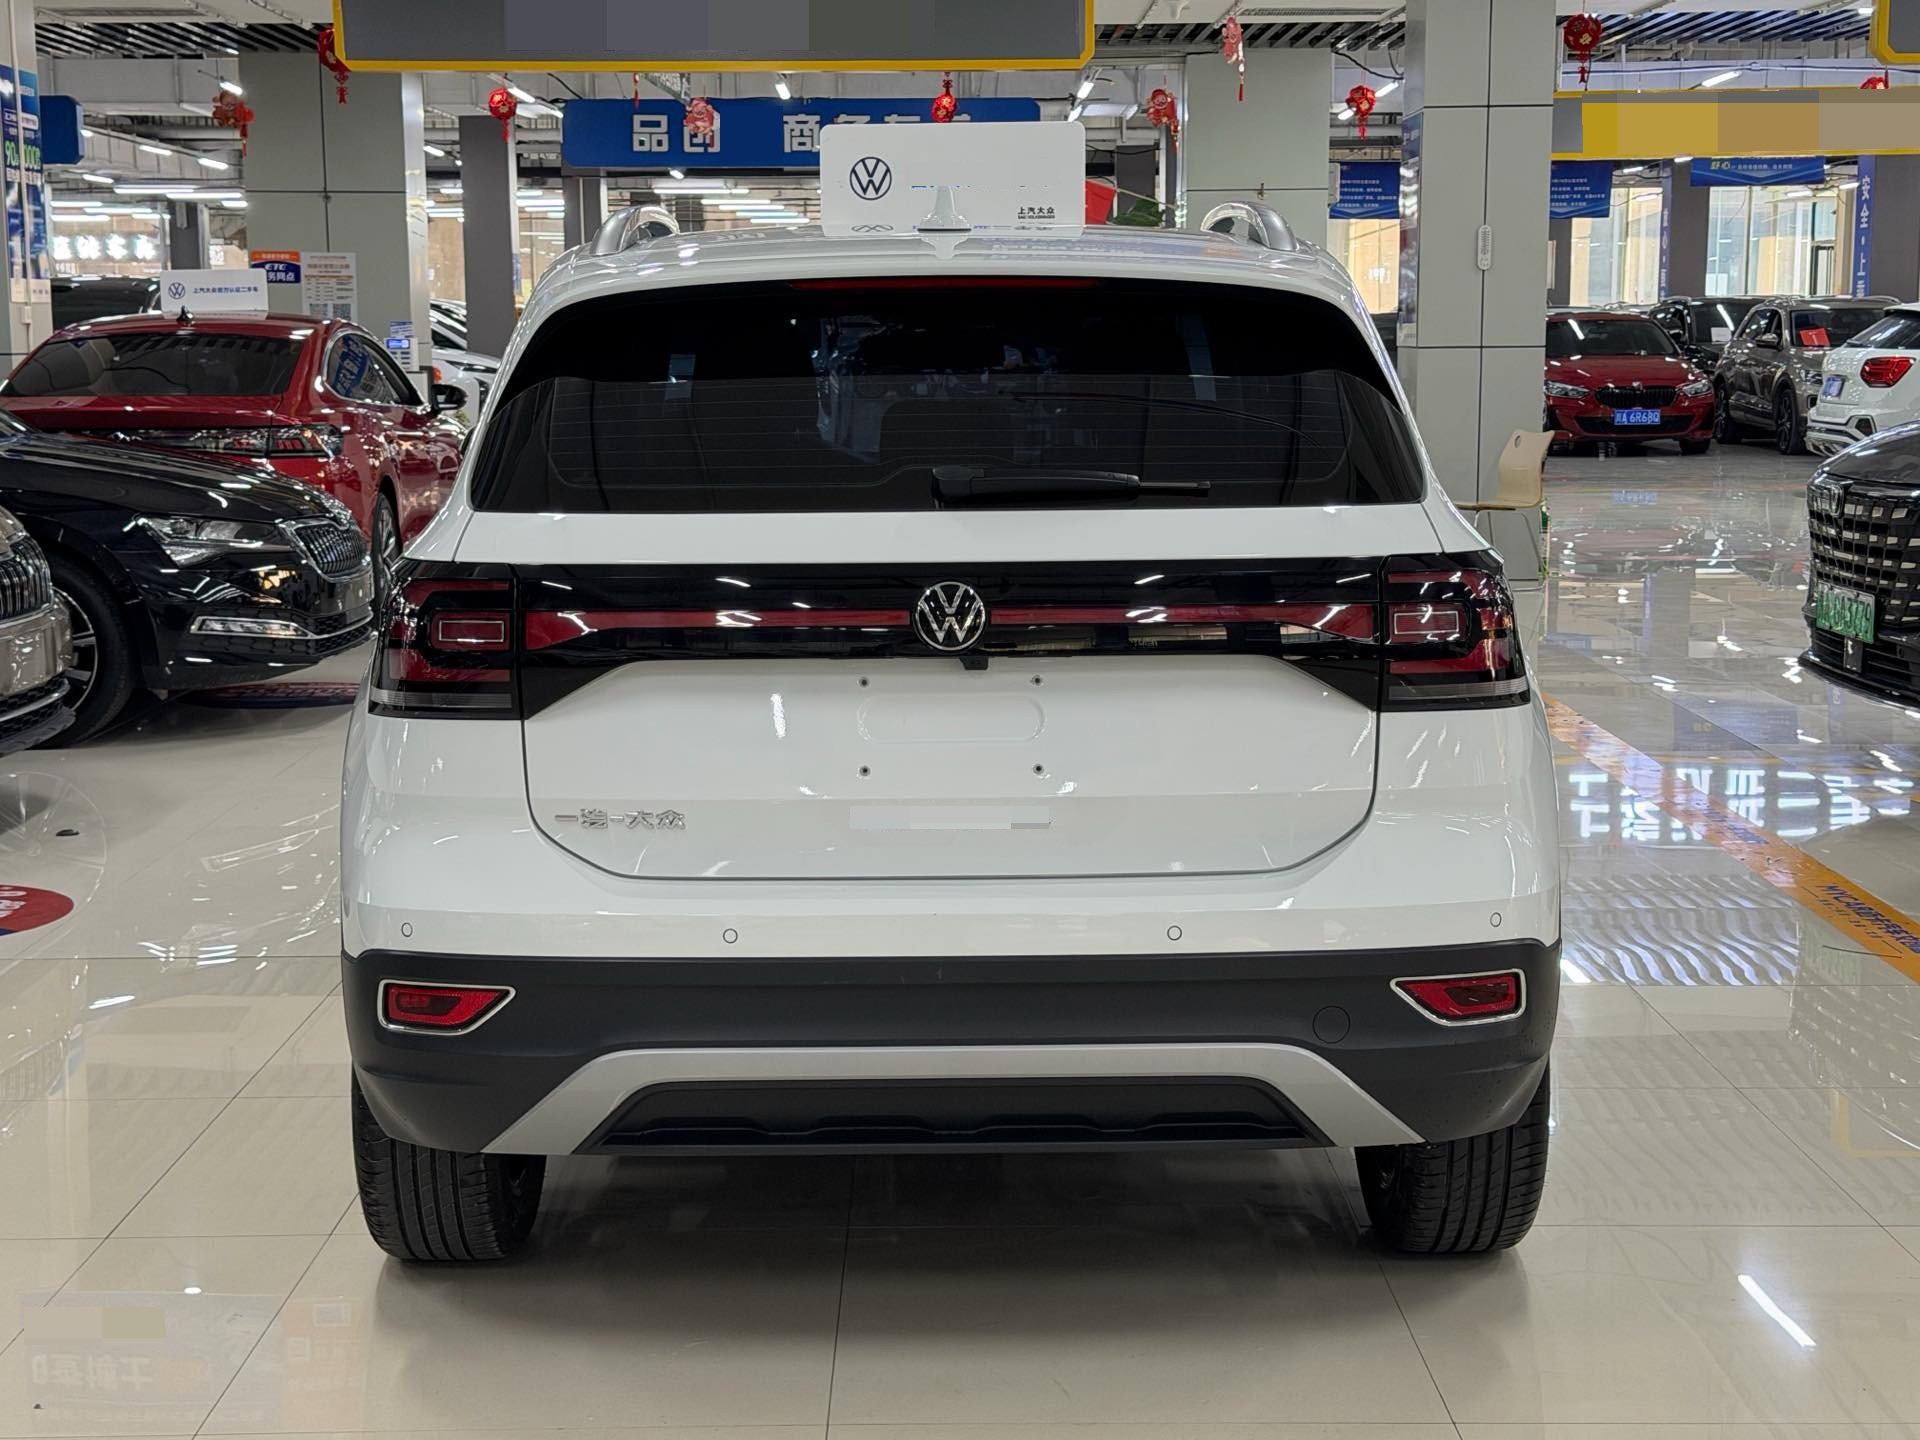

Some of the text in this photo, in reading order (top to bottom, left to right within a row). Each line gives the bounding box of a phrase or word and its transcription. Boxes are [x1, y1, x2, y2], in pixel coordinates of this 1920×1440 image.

[1017, 206, 1055, 215] 上汽大众
[267, 272, 296, 281] 务网点
